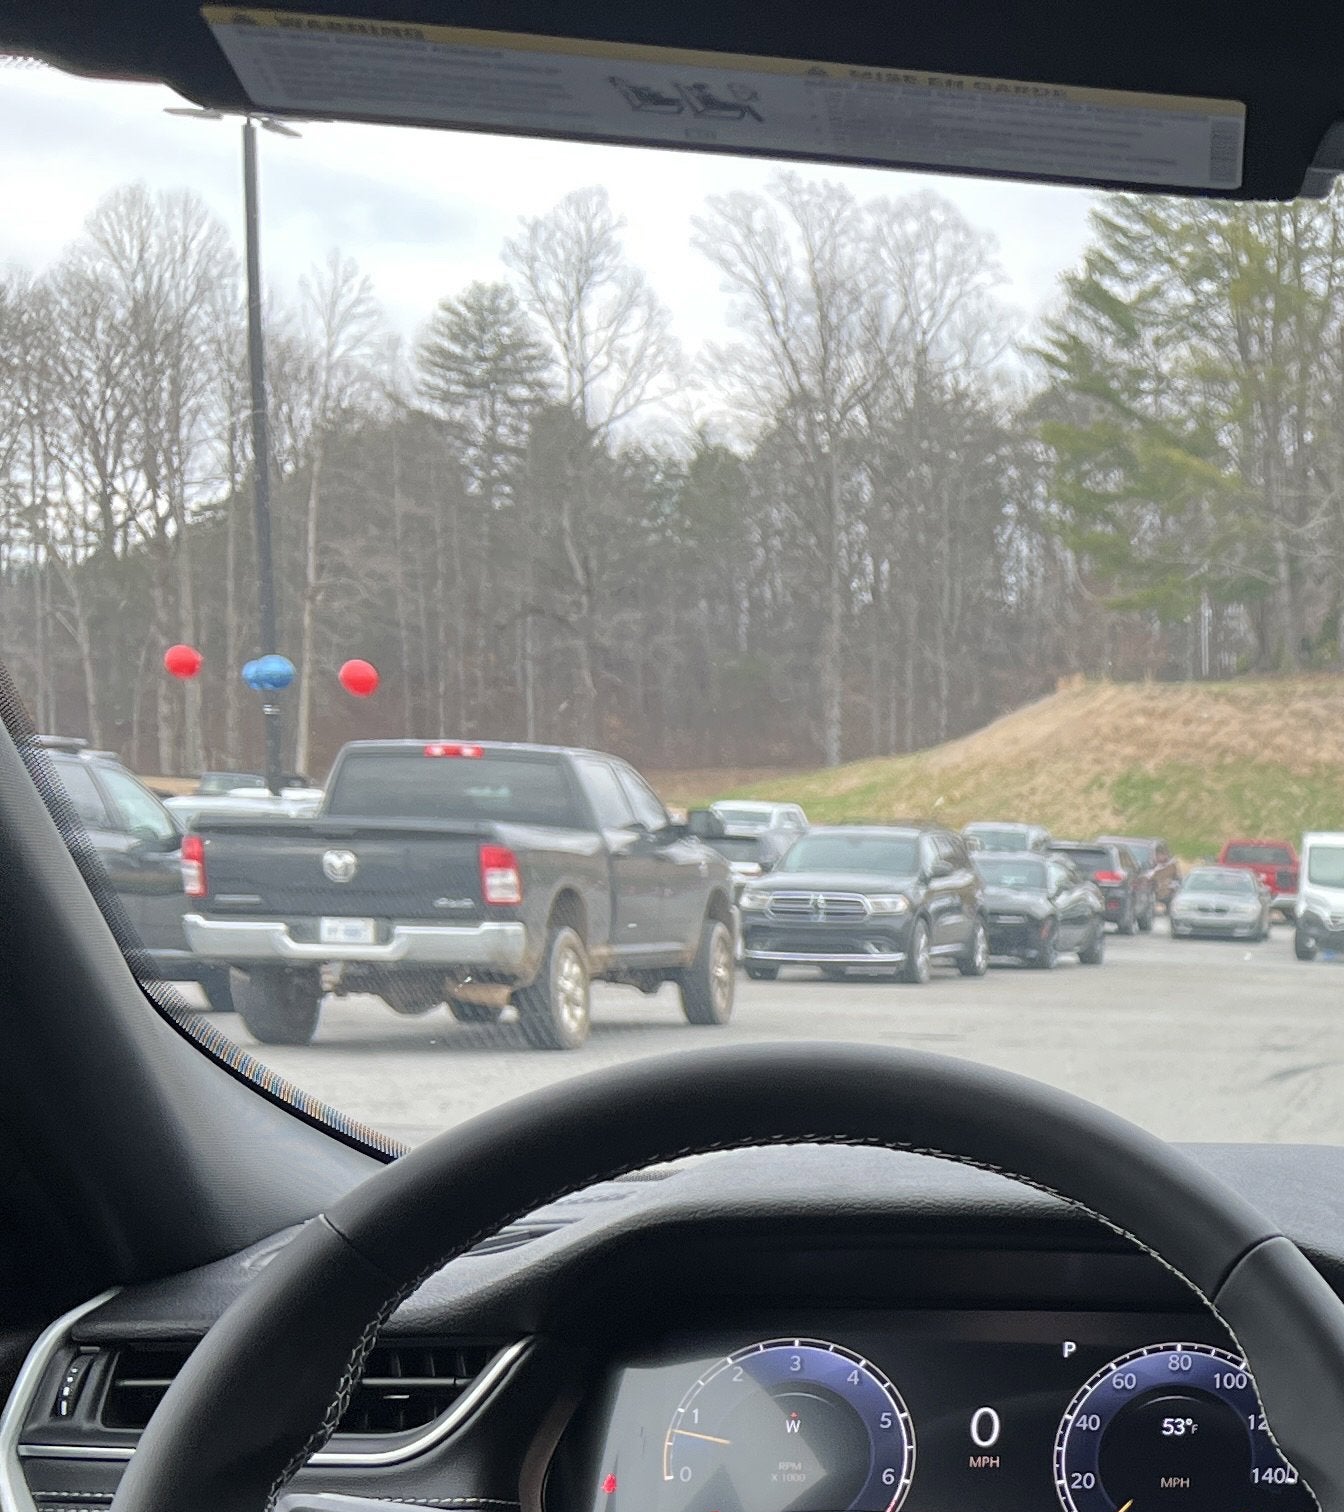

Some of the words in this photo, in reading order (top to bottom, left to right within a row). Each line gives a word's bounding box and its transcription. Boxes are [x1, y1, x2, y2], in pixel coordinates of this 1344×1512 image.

[1063, 1342, 1076, 1358] P
[790, 1356, 801, 1371] 3
[1168, 1355, 1192, 1371] 80
[733, 1367, 744, 1382] 2
[847, 1370, 860, 1386] 4
[1112, 1373, 1136, 1390] 60
[1213, 1373, 1248, 1389] 100
[692, 1409, 700, 1423] 1
[880, 1413, 892, 1428] 5
[1076, 1414, 1100, 1431] 40
[1248, 1415, 1268, 1431] 12
[785, 1420, 800, 1433] W
[970, 1407, 1000, 1448] 0
[779, 1461, 802, 1471] RPM
[969, 1455, 1000, 1468] MPH
[680, 1467, 692, 1482] 0
[781, 1473, 806, 1482] 1000
[882, 1468, 895, 1485] 6
[1071, 1473, 1095, 1489] 20
[1161, 1477, 1190, 1488] MPH
[1252, 1468, 1286, 1484] 140
